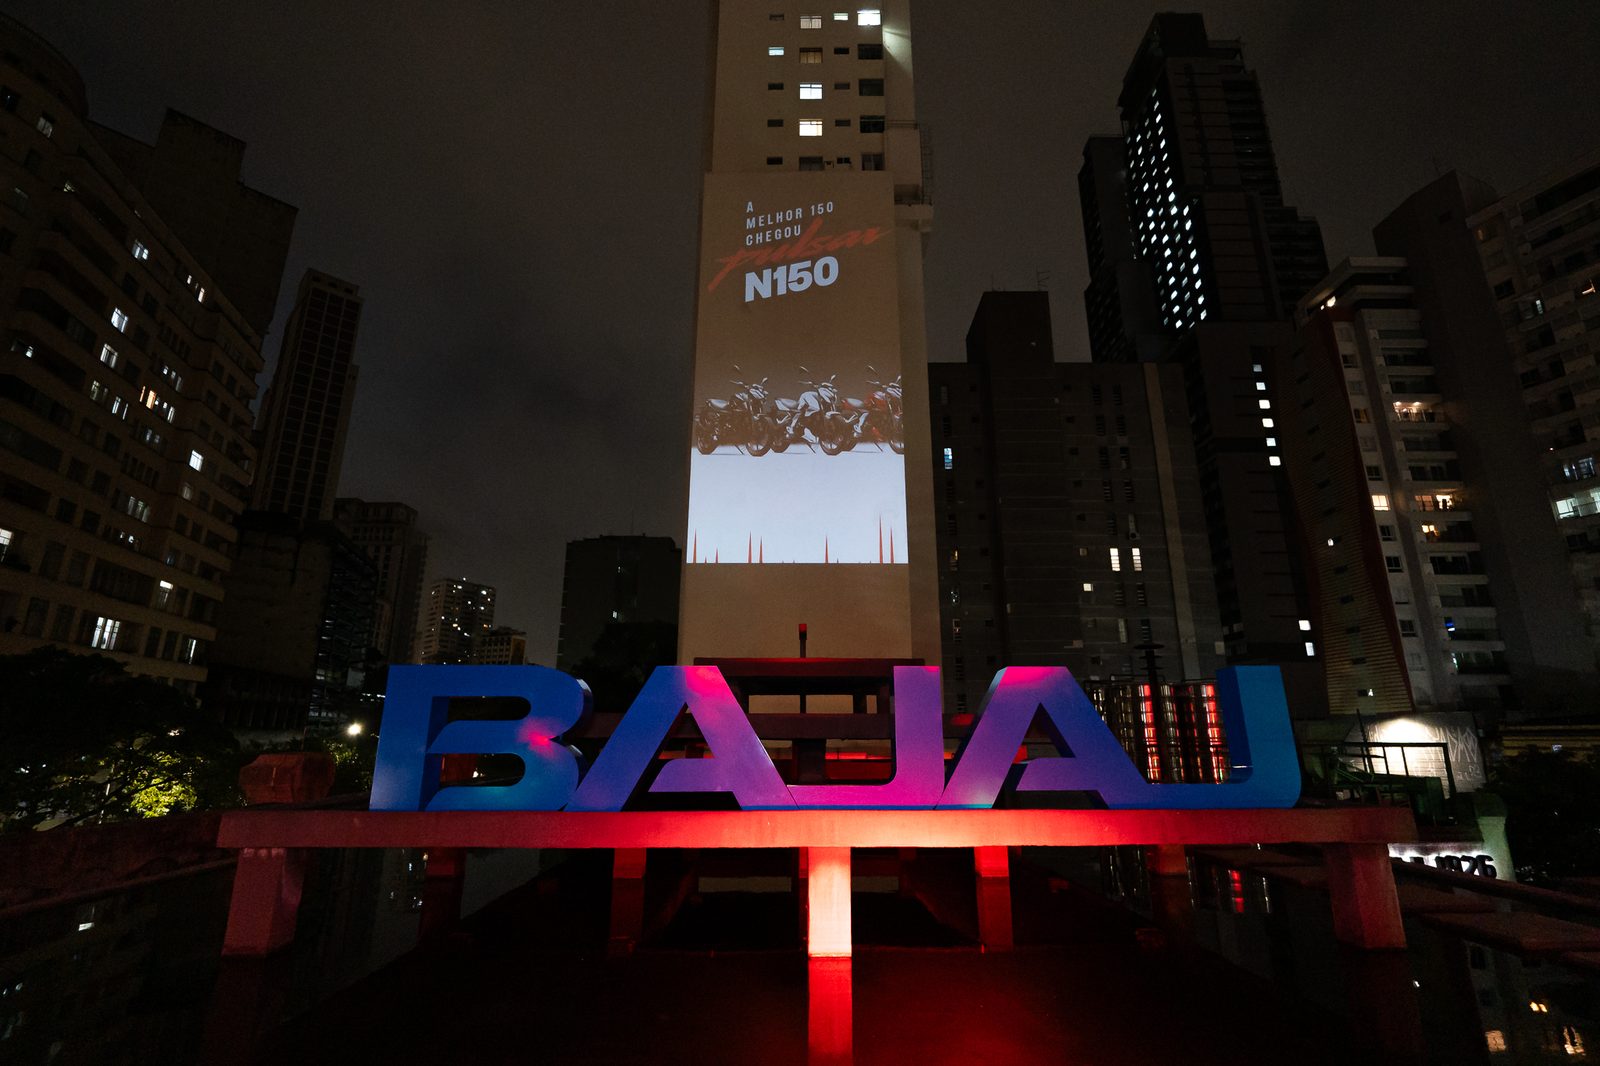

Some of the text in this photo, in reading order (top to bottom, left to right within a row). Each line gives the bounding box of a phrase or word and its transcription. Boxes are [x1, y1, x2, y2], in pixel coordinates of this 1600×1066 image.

[746, 201, 754, 213] A
[746, 201, 834, 229] MELHOR 150
[746, 224, 801, 246] CHEGOU
[745, 255, 839, 303] N150
[369, 665, 1302, 811] BAJAJ
